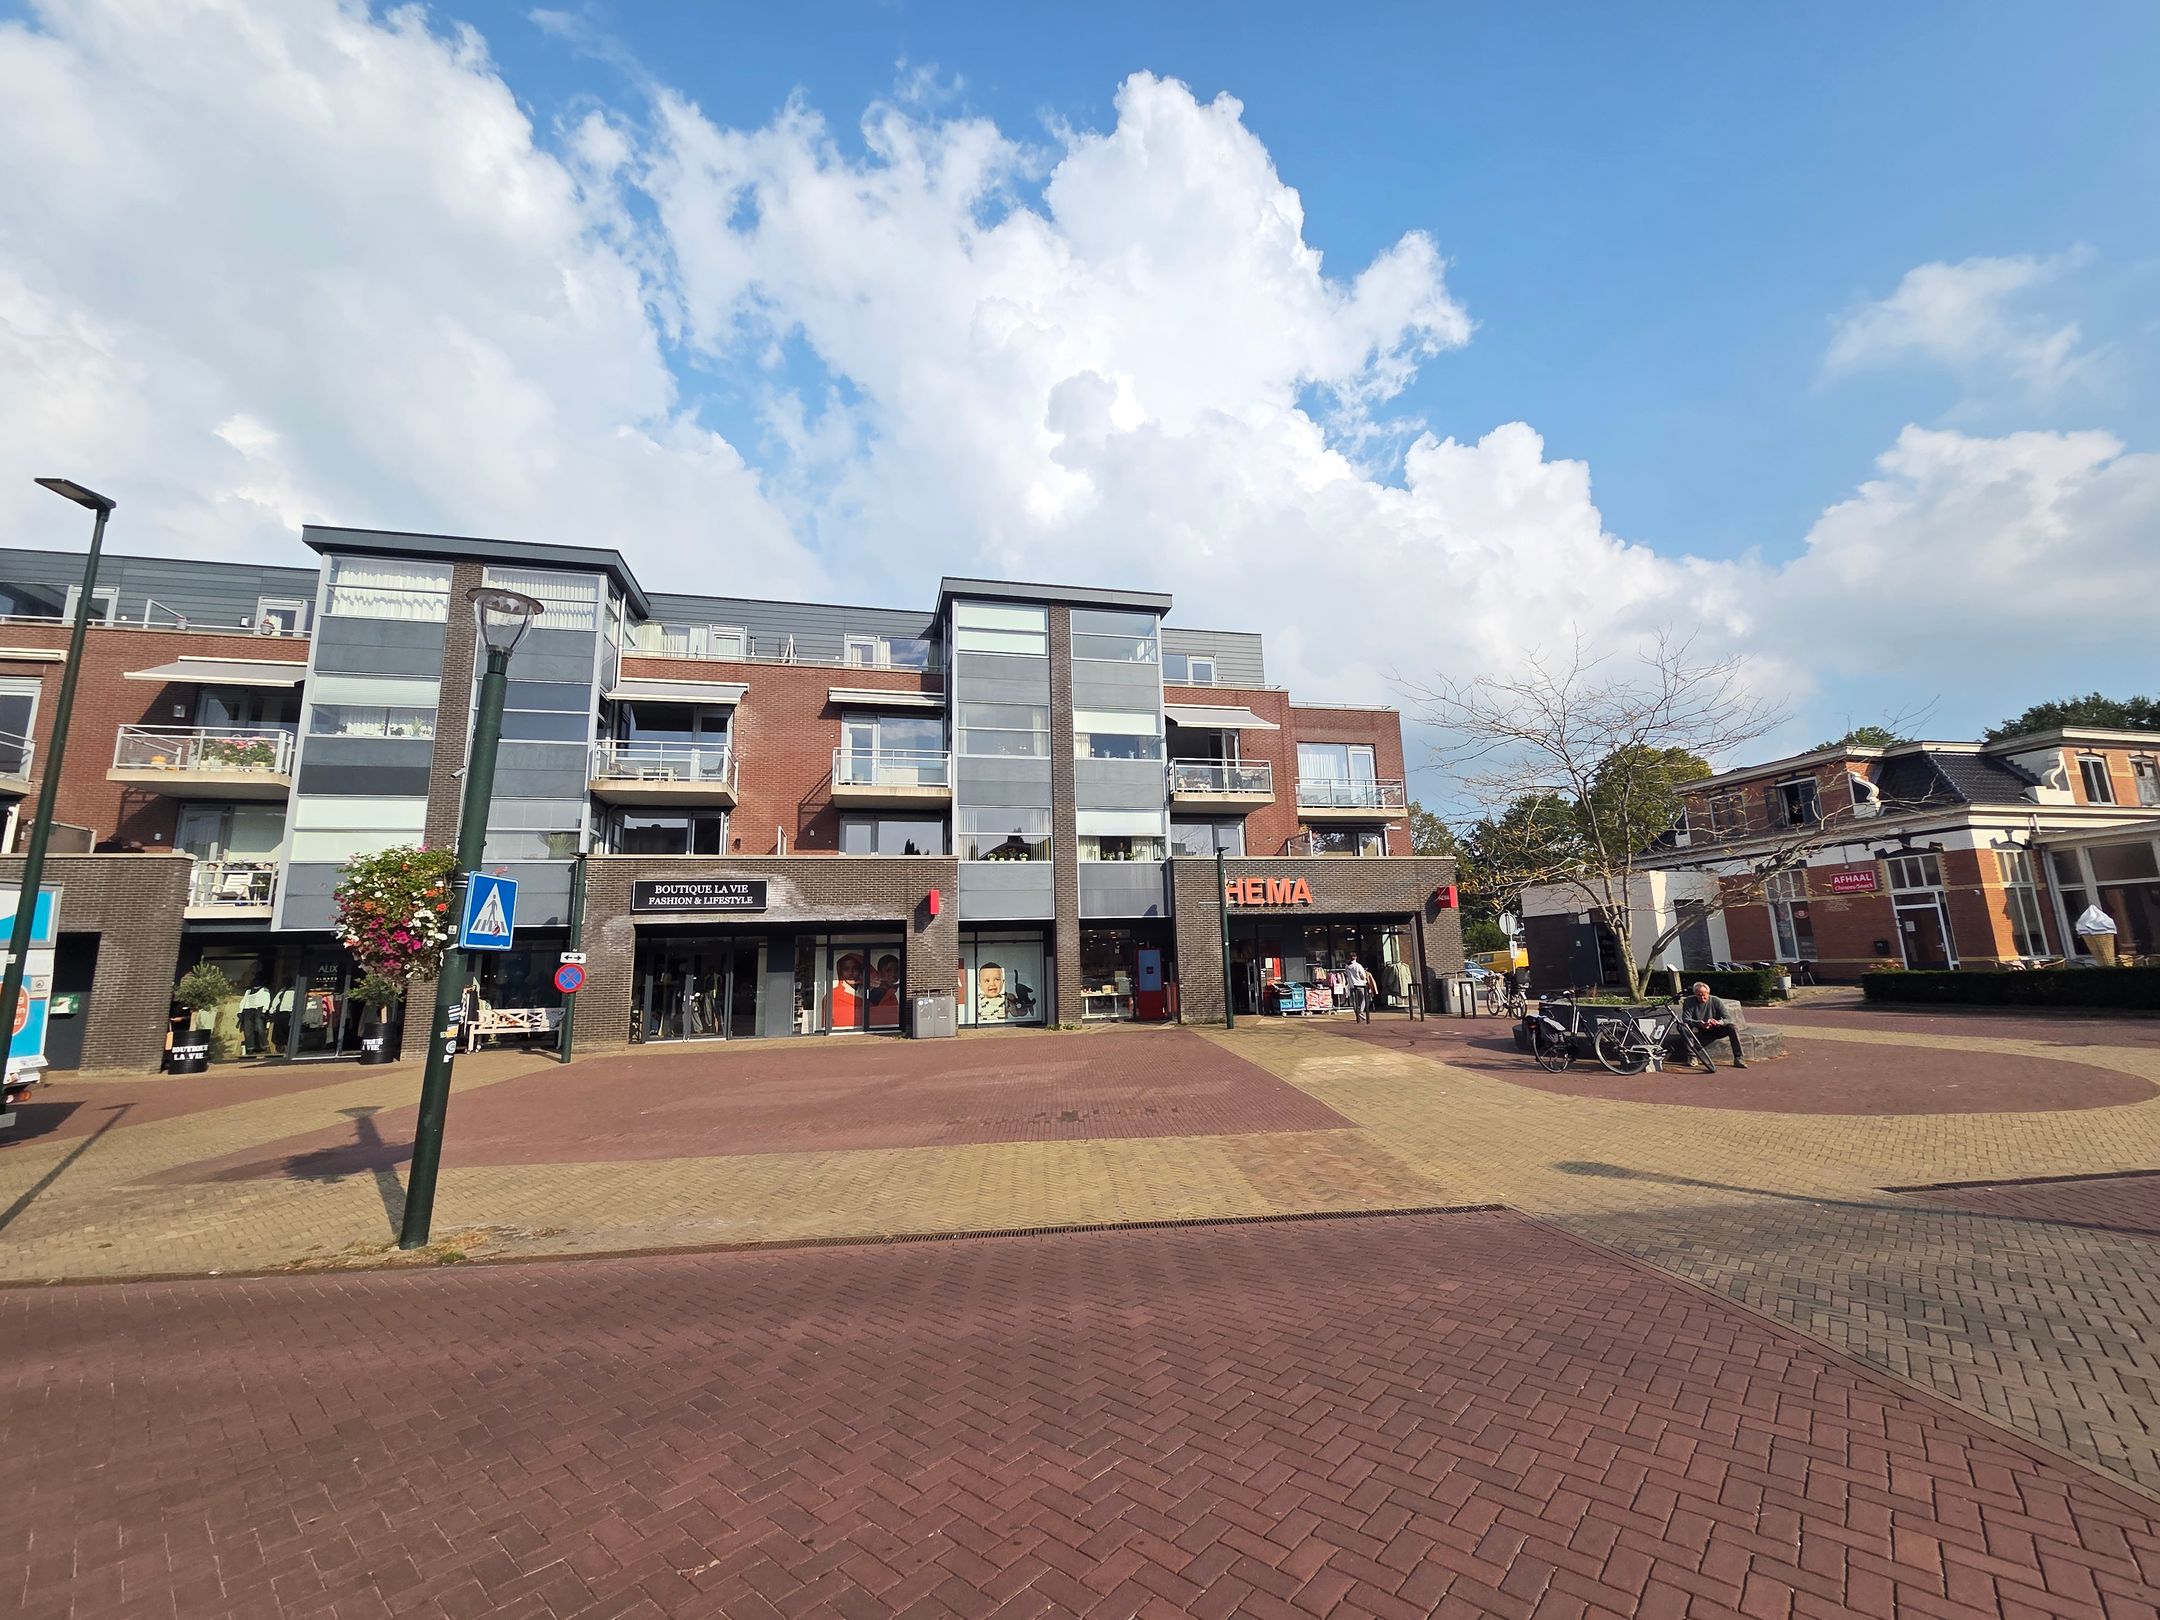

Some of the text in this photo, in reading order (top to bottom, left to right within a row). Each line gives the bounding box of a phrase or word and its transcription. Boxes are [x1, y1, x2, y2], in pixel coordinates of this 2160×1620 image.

[1834, 873, 1872, 884] AFHAAL
[655, 884, 749, 895] BOUTIQUE LA VIE
[1225, 878, 1313, 904] HEMA
[649, 896, 753, 905] FASHION & LIFESTYLE
[173, 1052, 204, 1061] LA VIE
